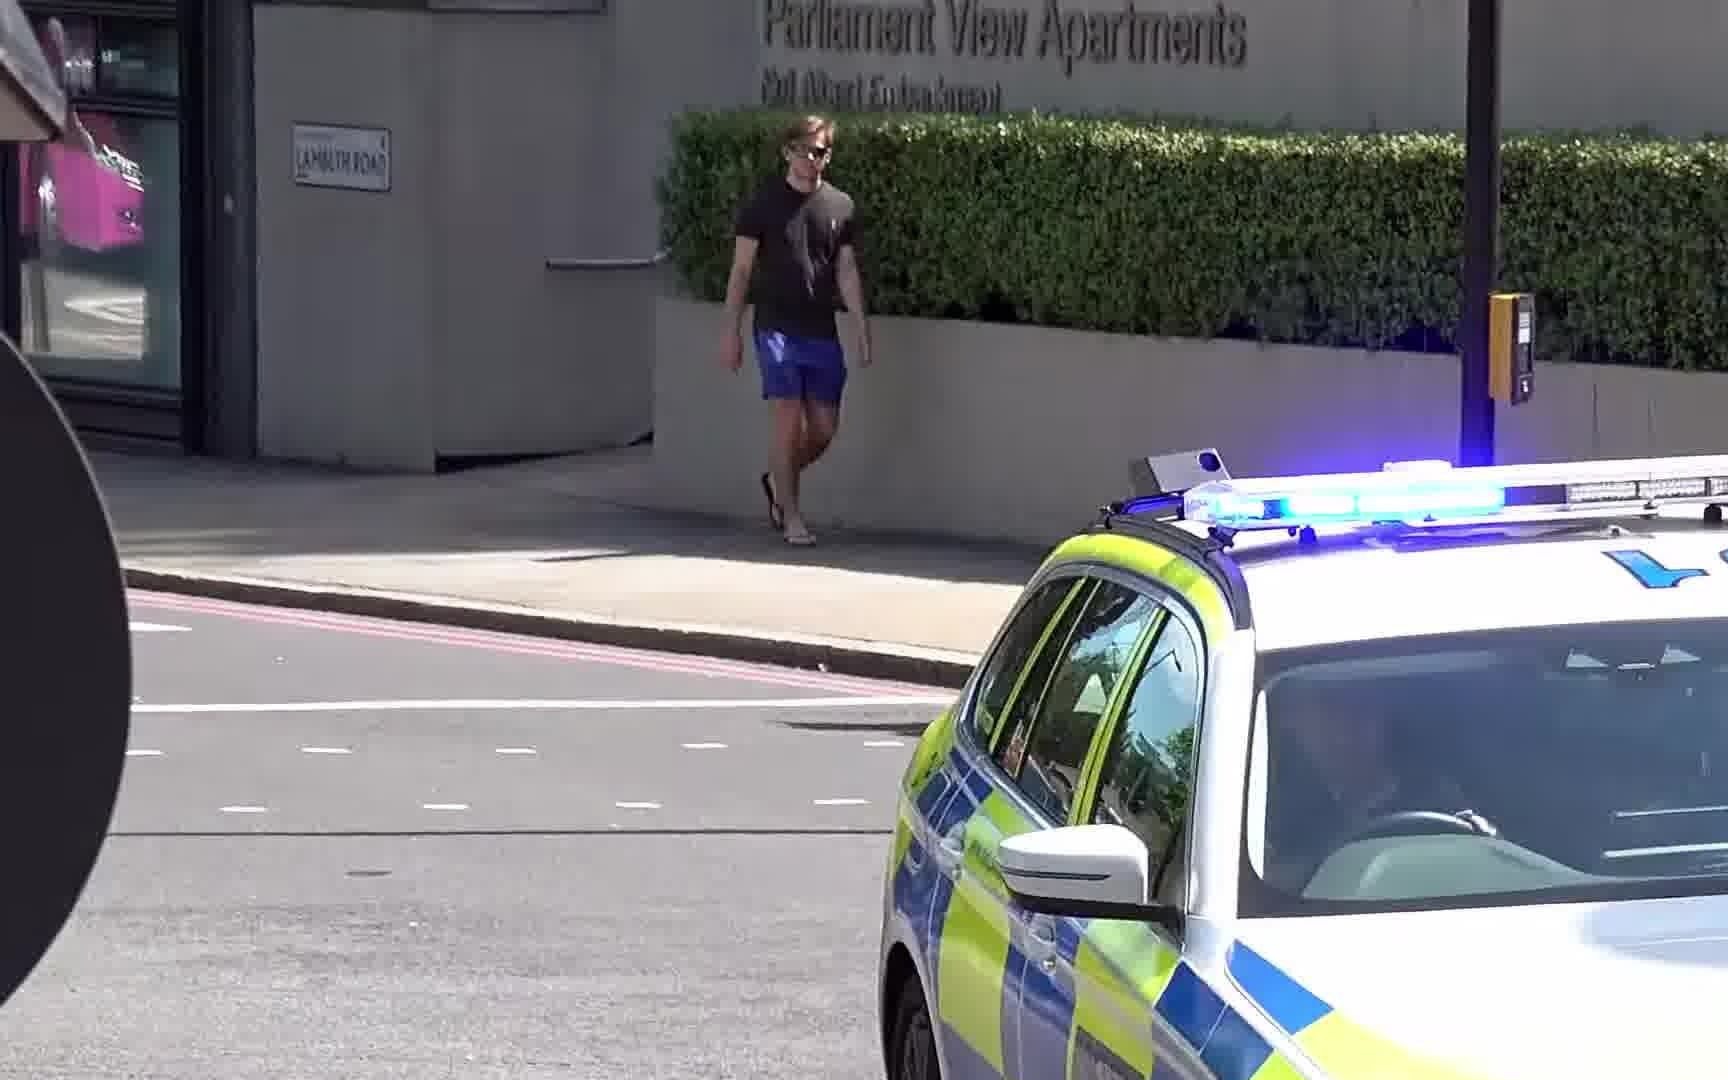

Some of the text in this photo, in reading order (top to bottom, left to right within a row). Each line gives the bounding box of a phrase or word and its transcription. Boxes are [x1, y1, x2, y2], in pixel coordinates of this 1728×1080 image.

[762, 0, 1249, 78] Parliament View Apartments
[353, 149, 385, 176] ROAD
